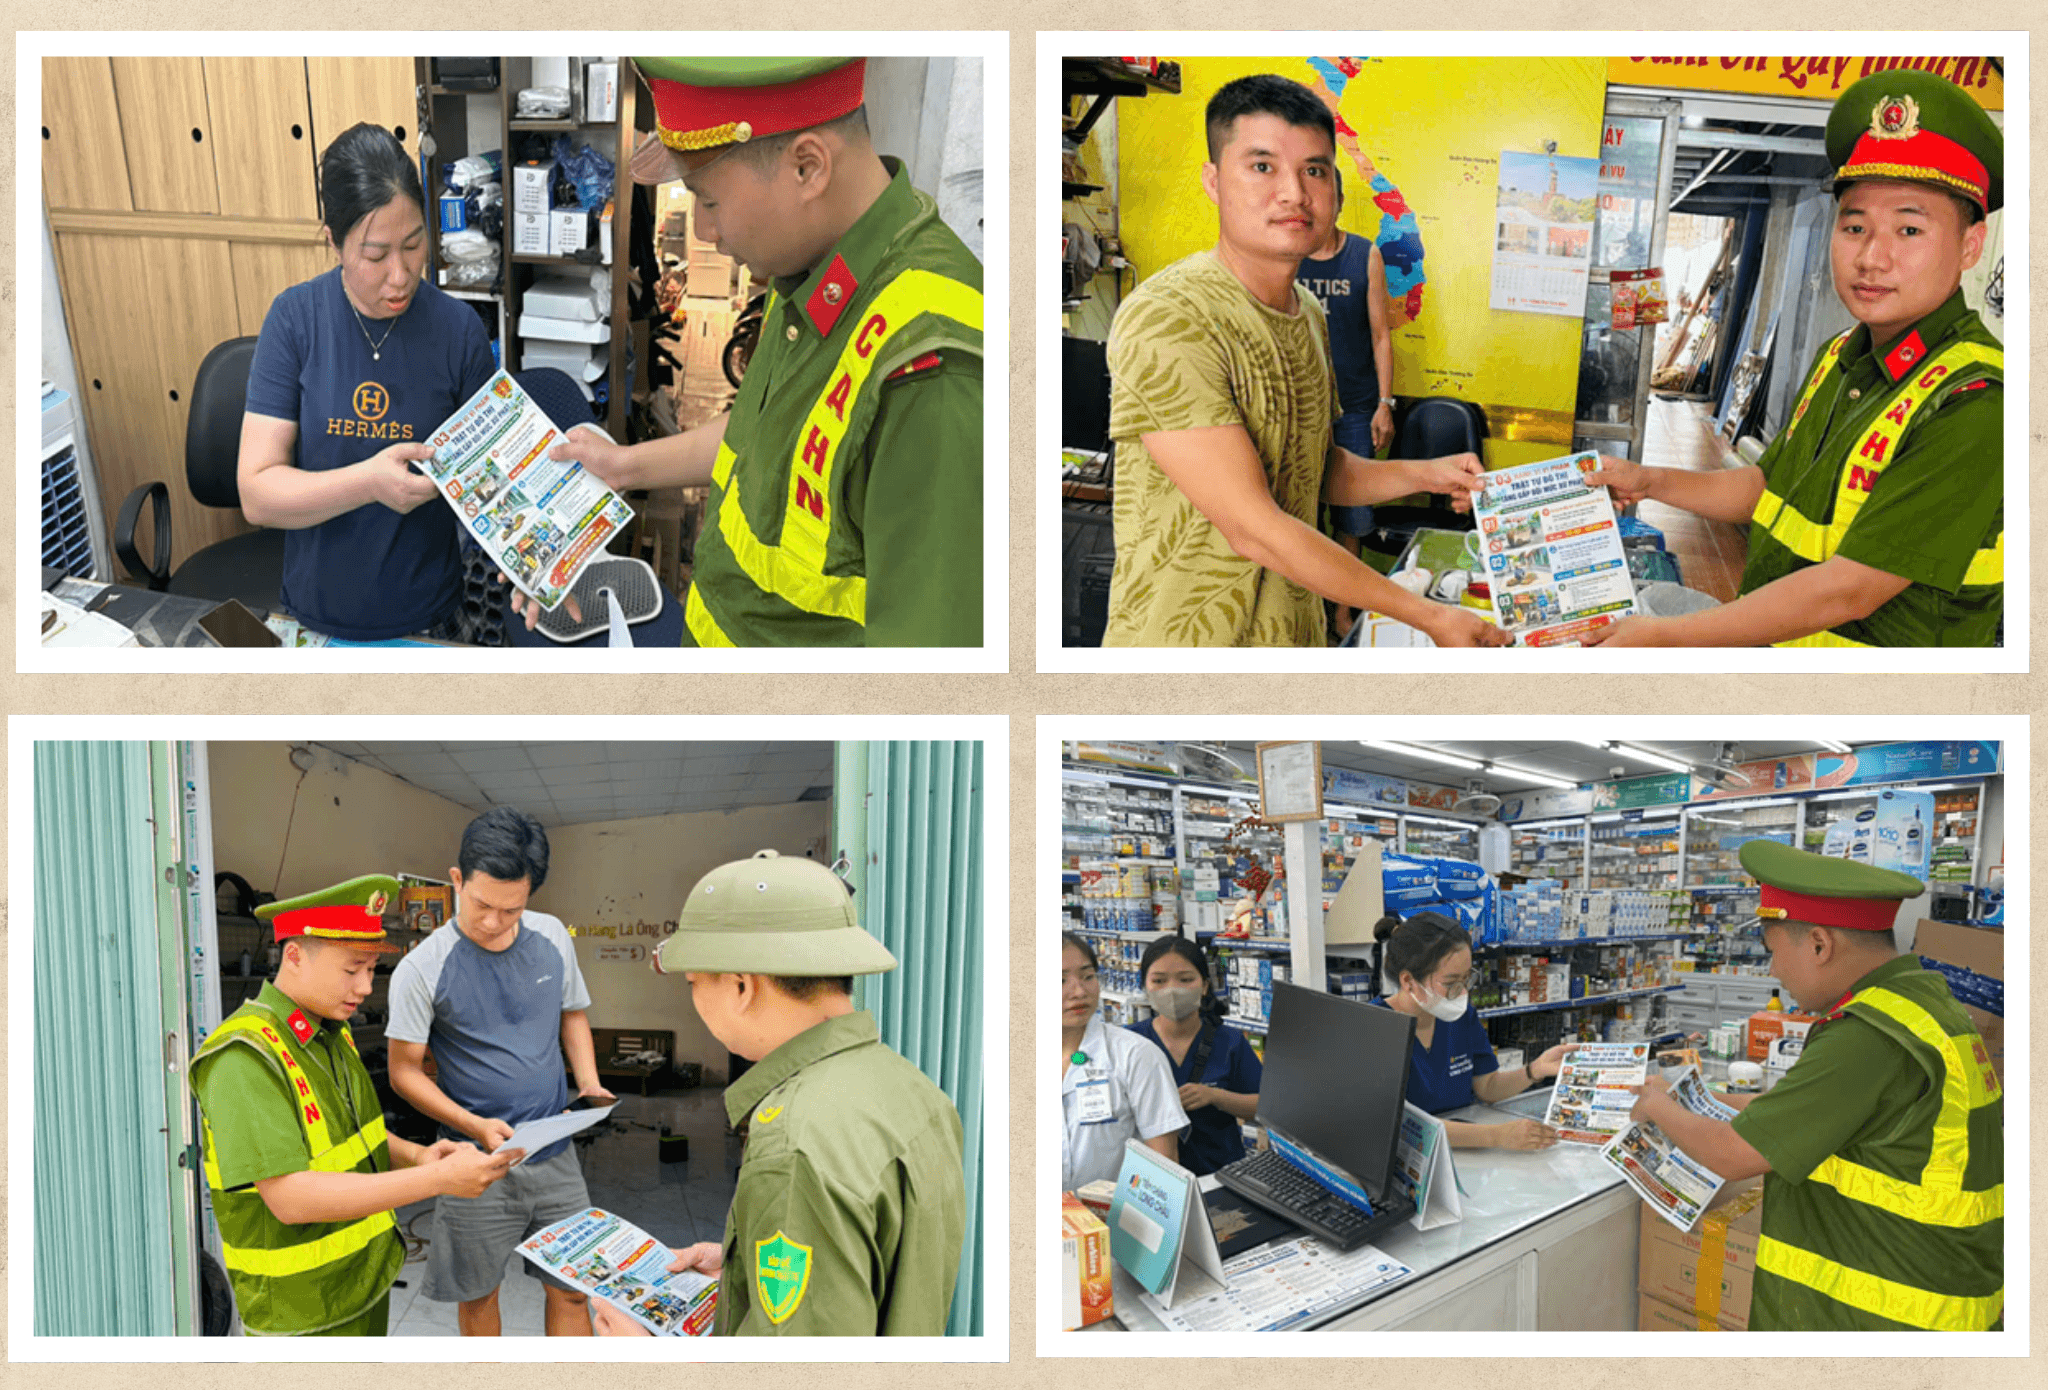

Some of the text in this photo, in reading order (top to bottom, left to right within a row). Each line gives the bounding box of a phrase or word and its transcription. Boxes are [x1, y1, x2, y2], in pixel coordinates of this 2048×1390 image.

[1295, 278, 1351, 296] LTICS
[433, 431, 450, 447] 03
[796, 313, 887, 521] CAHN
[1847, 365, 1948, 493] CAHN
[261, 1027, 321, 1125] CAHN
